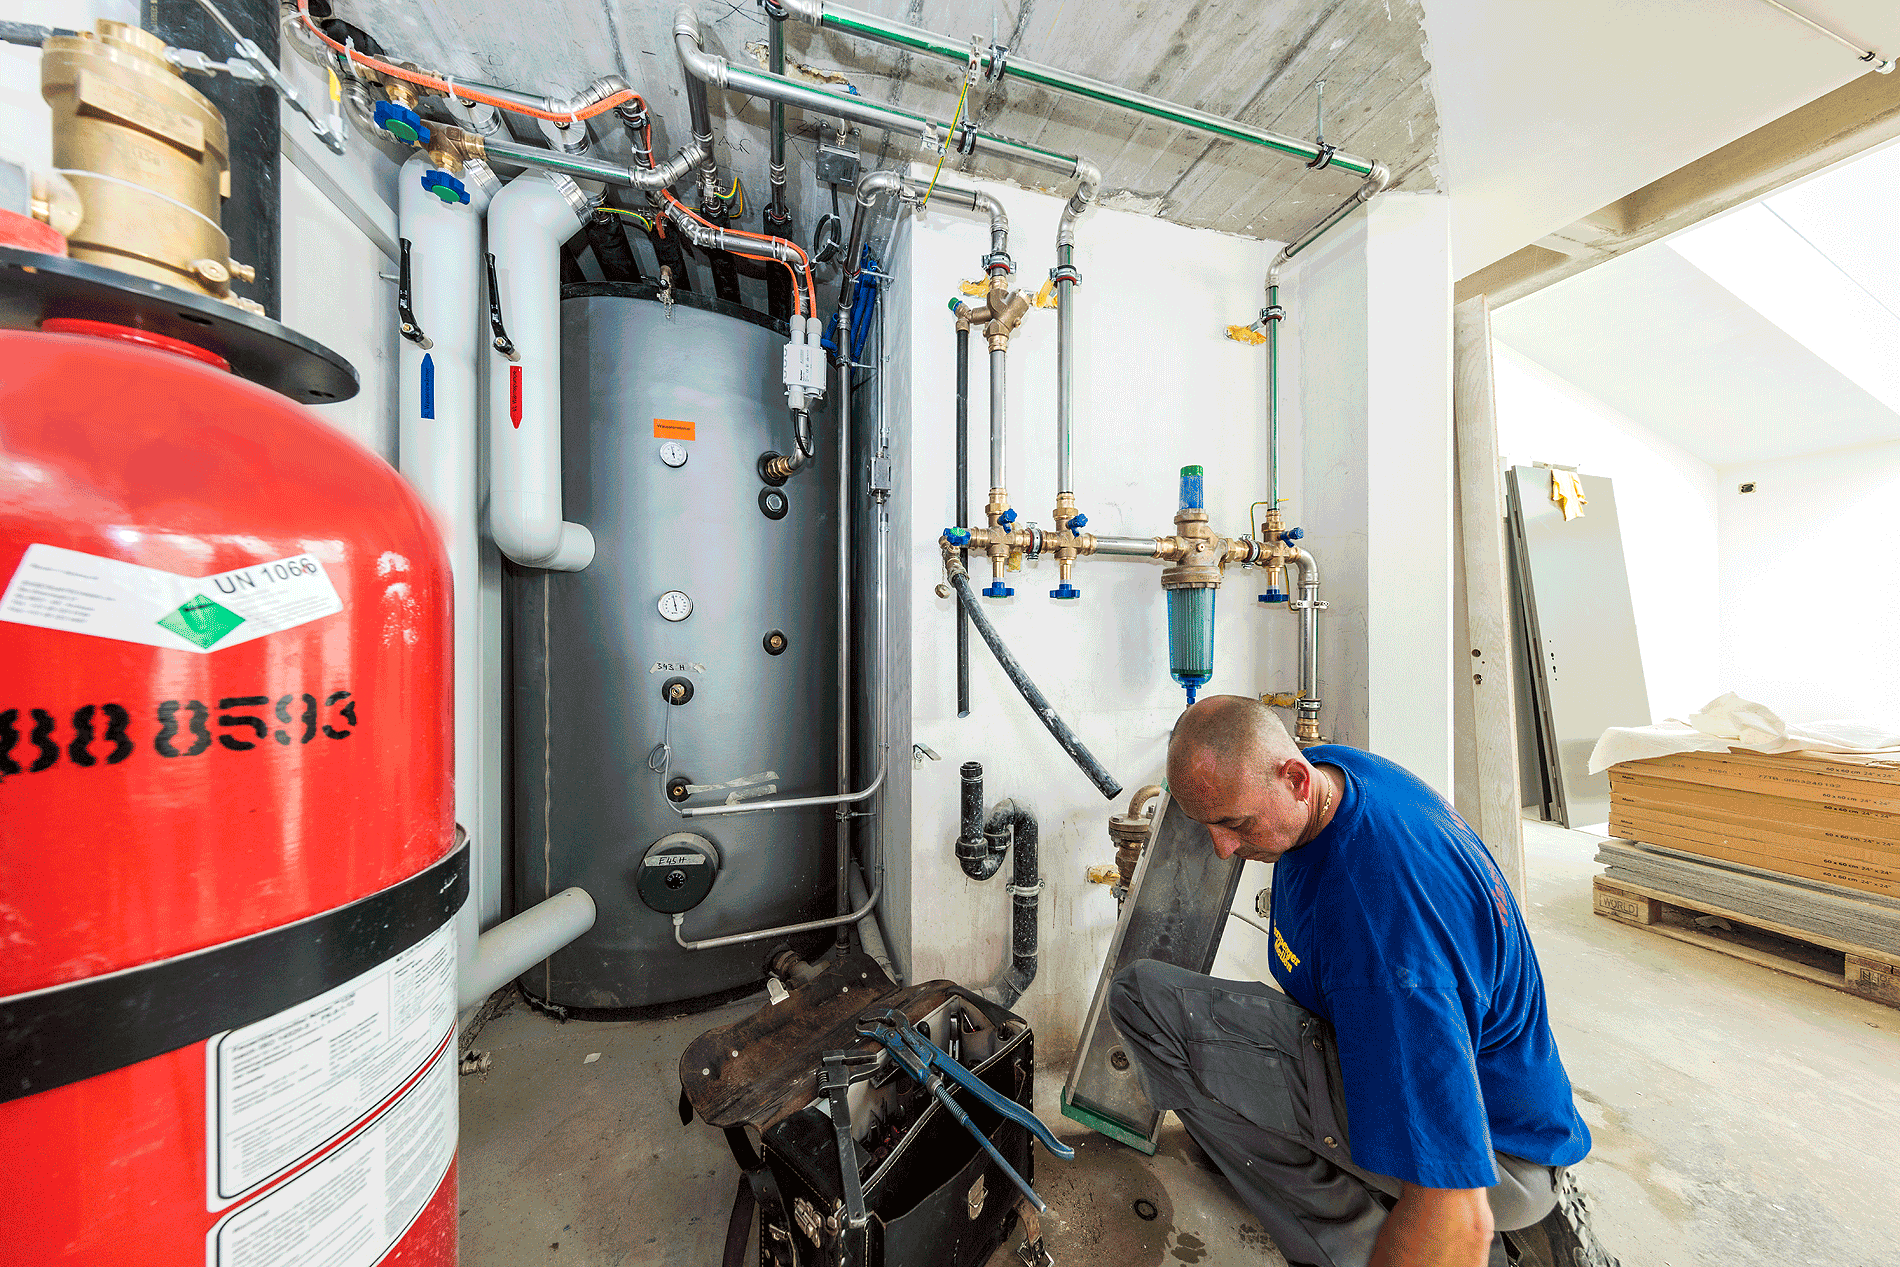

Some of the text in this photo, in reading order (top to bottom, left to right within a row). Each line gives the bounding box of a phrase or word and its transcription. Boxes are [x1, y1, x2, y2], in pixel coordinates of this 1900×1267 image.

[214, 557, 318, 594] UN 1066
[154, 690, 358, 758] 8593
[1603, 897, 1635, 914] WORLD
